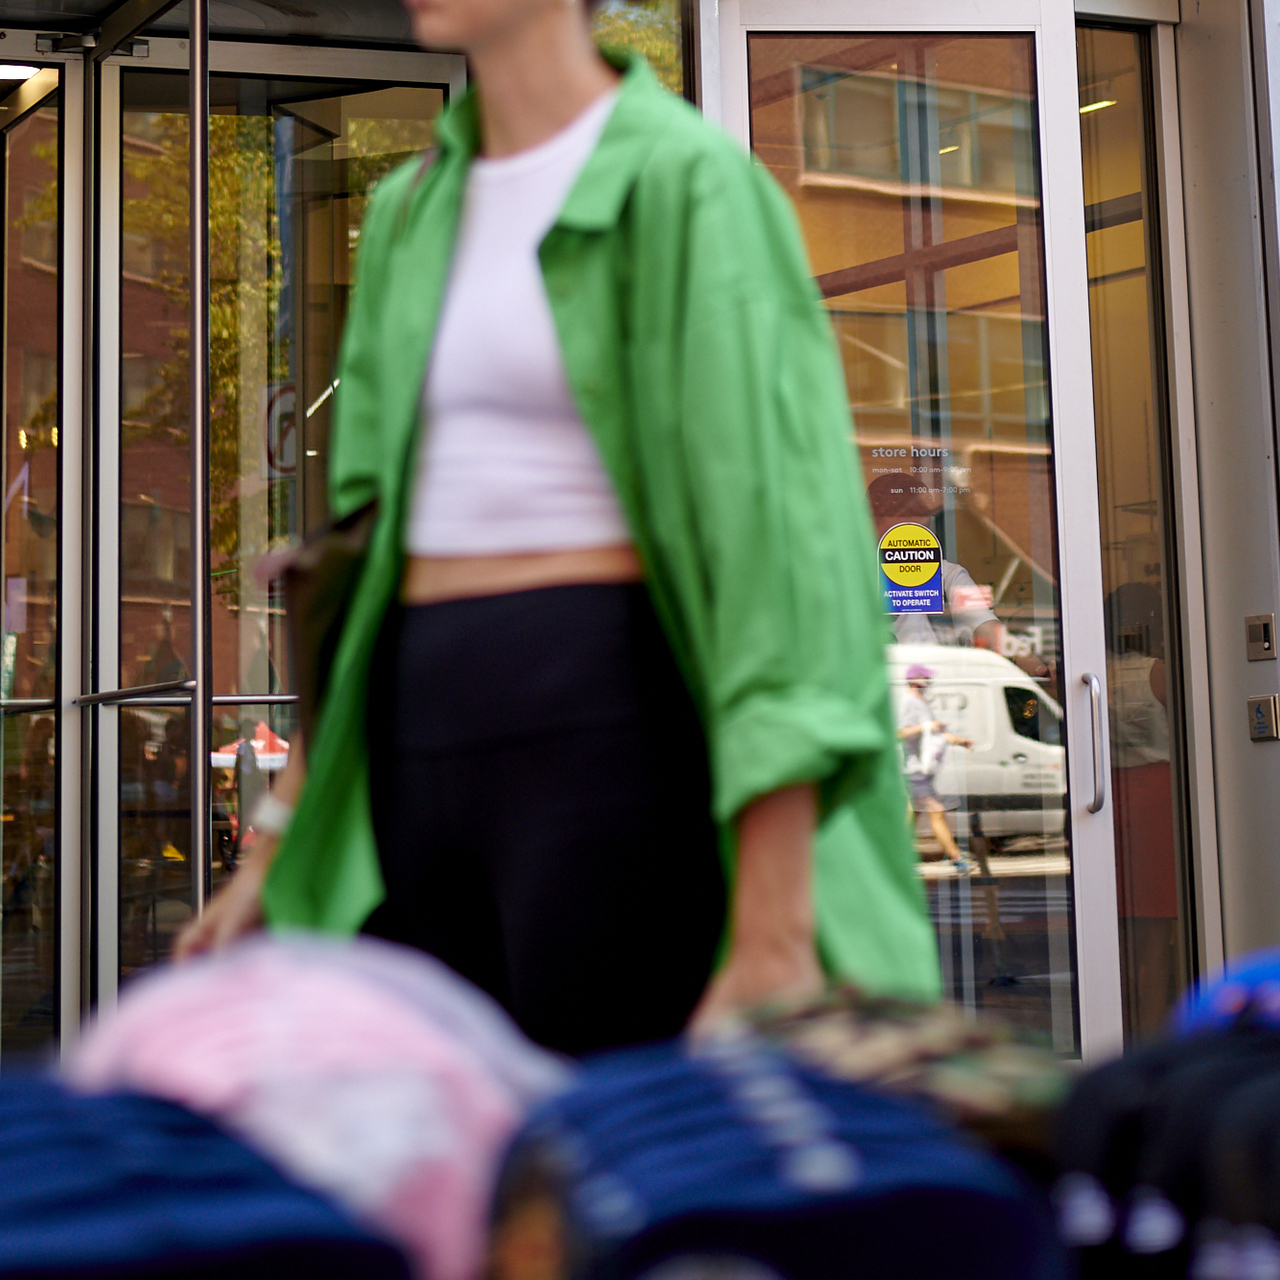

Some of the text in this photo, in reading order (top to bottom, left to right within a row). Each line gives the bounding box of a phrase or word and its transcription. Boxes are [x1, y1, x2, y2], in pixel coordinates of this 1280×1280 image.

[872, 446, 949, 458] store hours
[887, 539, 931, 547] AUTOMATIC
[885, 550, 934, 561] CAUTION
[899, 565, 922, 573] DOOR
[914, 589, 939, 597] SWITCH
[892, 599, 901, 607] TO
